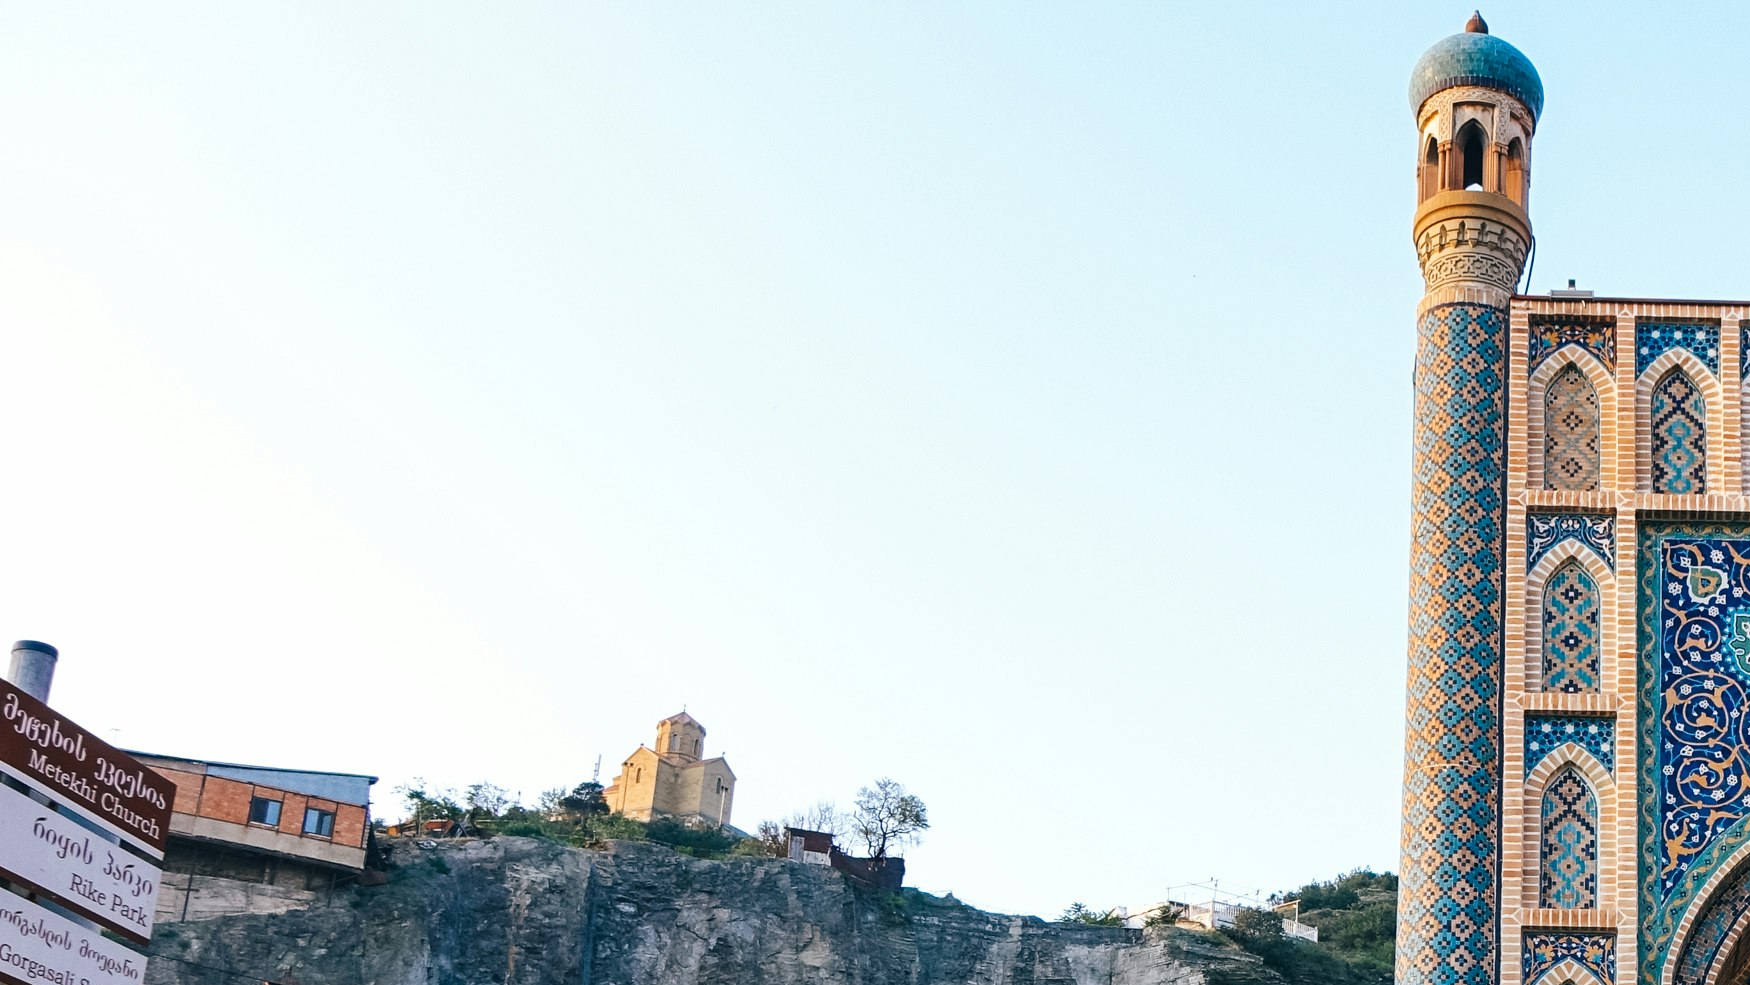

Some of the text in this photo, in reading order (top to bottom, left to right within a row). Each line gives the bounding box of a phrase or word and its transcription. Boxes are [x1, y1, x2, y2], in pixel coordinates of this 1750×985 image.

[4, 692, 166, 810] მეტეხის ეკლესია
[28, 748, 160, 840] Metekhi Church
[33, 817, 153, 897] რიყის პარკი
[69, 872, 148, 928] Rike Park
[79, 939, 138, 981] მოედანი
